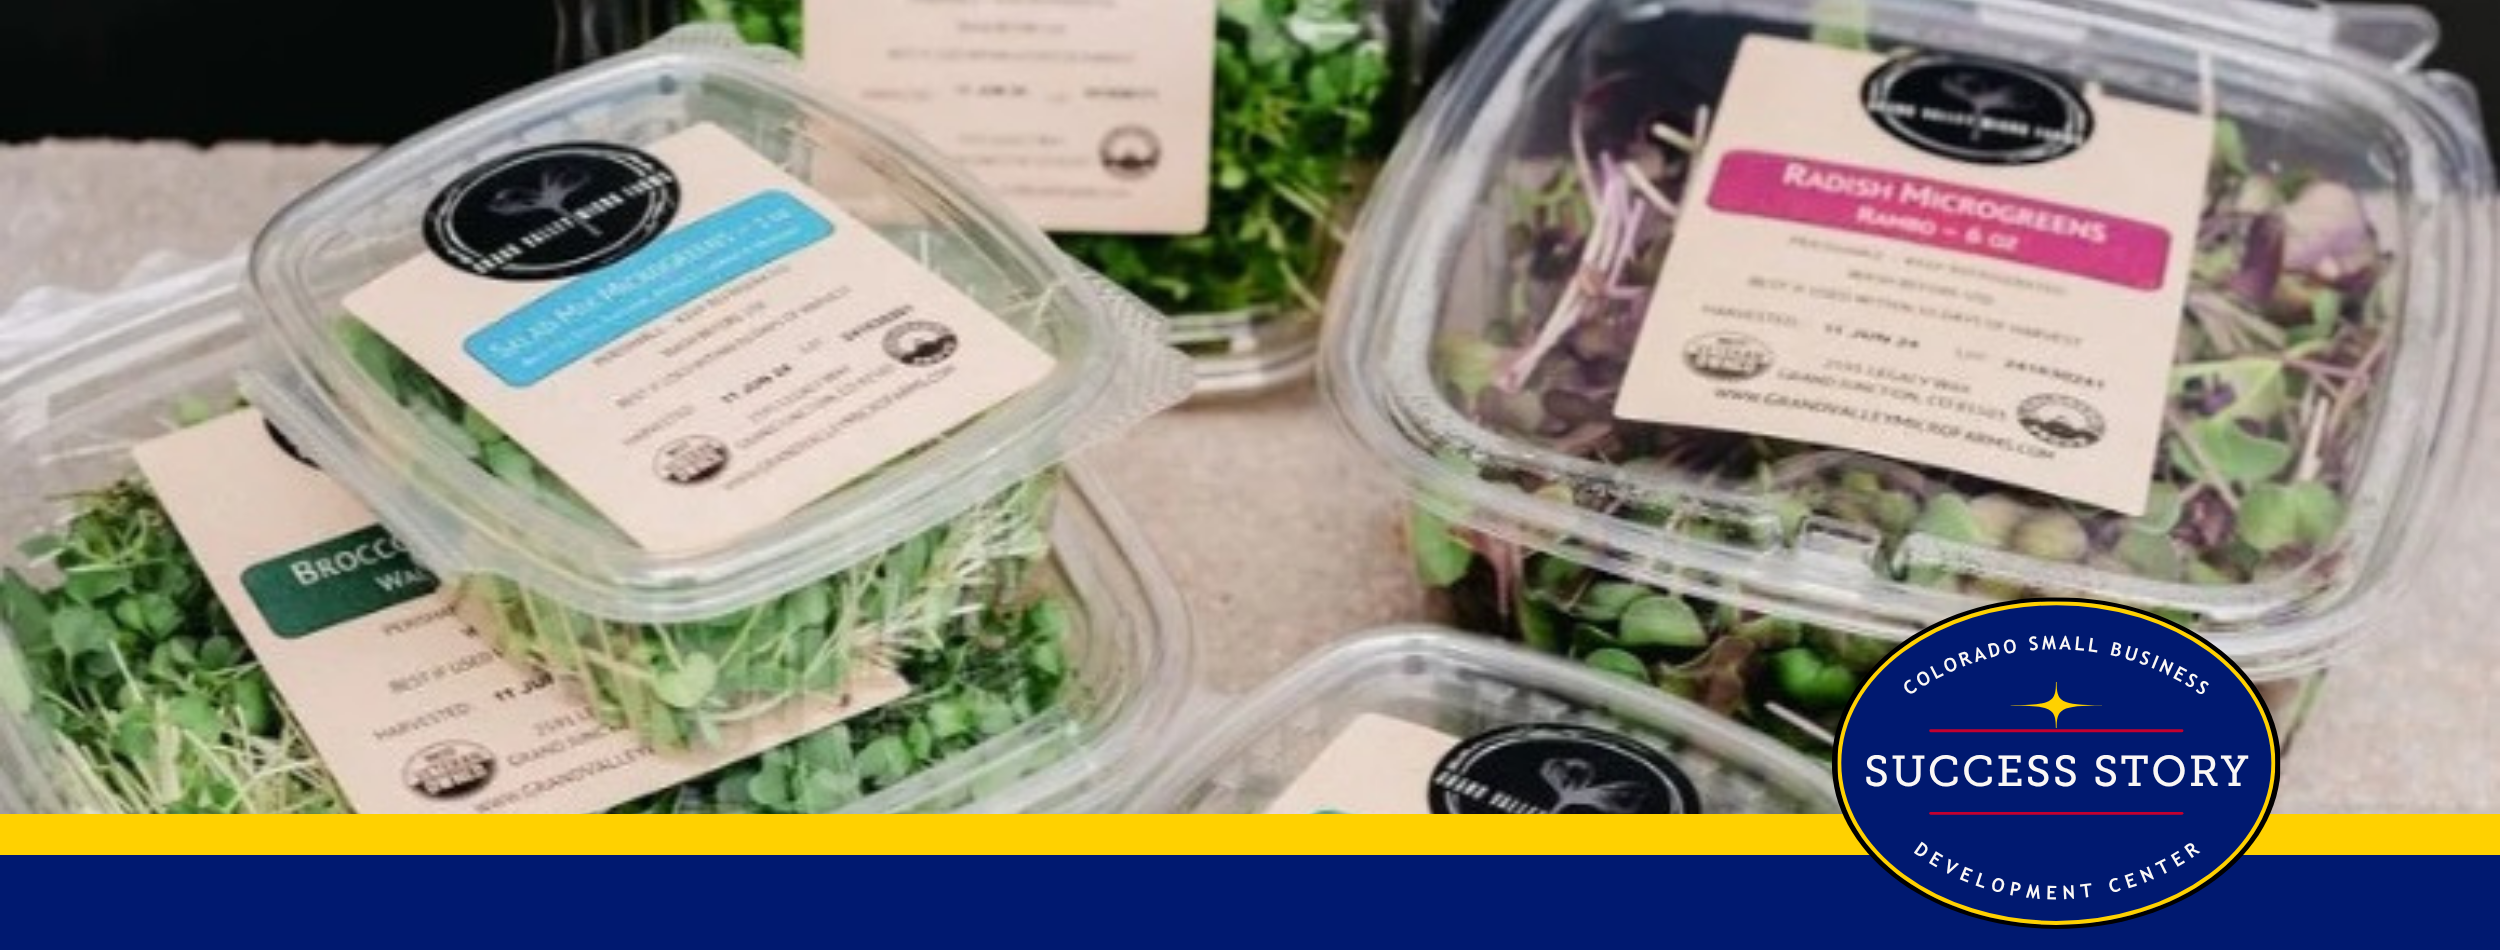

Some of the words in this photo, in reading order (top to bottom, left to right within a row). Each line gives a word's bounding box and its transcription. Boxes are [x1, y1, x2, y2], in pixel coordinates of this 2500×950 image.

[1783, 163, 1892, 202] RADISH
[1899, 180, 2108, 244] MICROGREENS
[1856, 206, 1936, 236] RAMBO
[1965, 225, 1981, 245] 6
